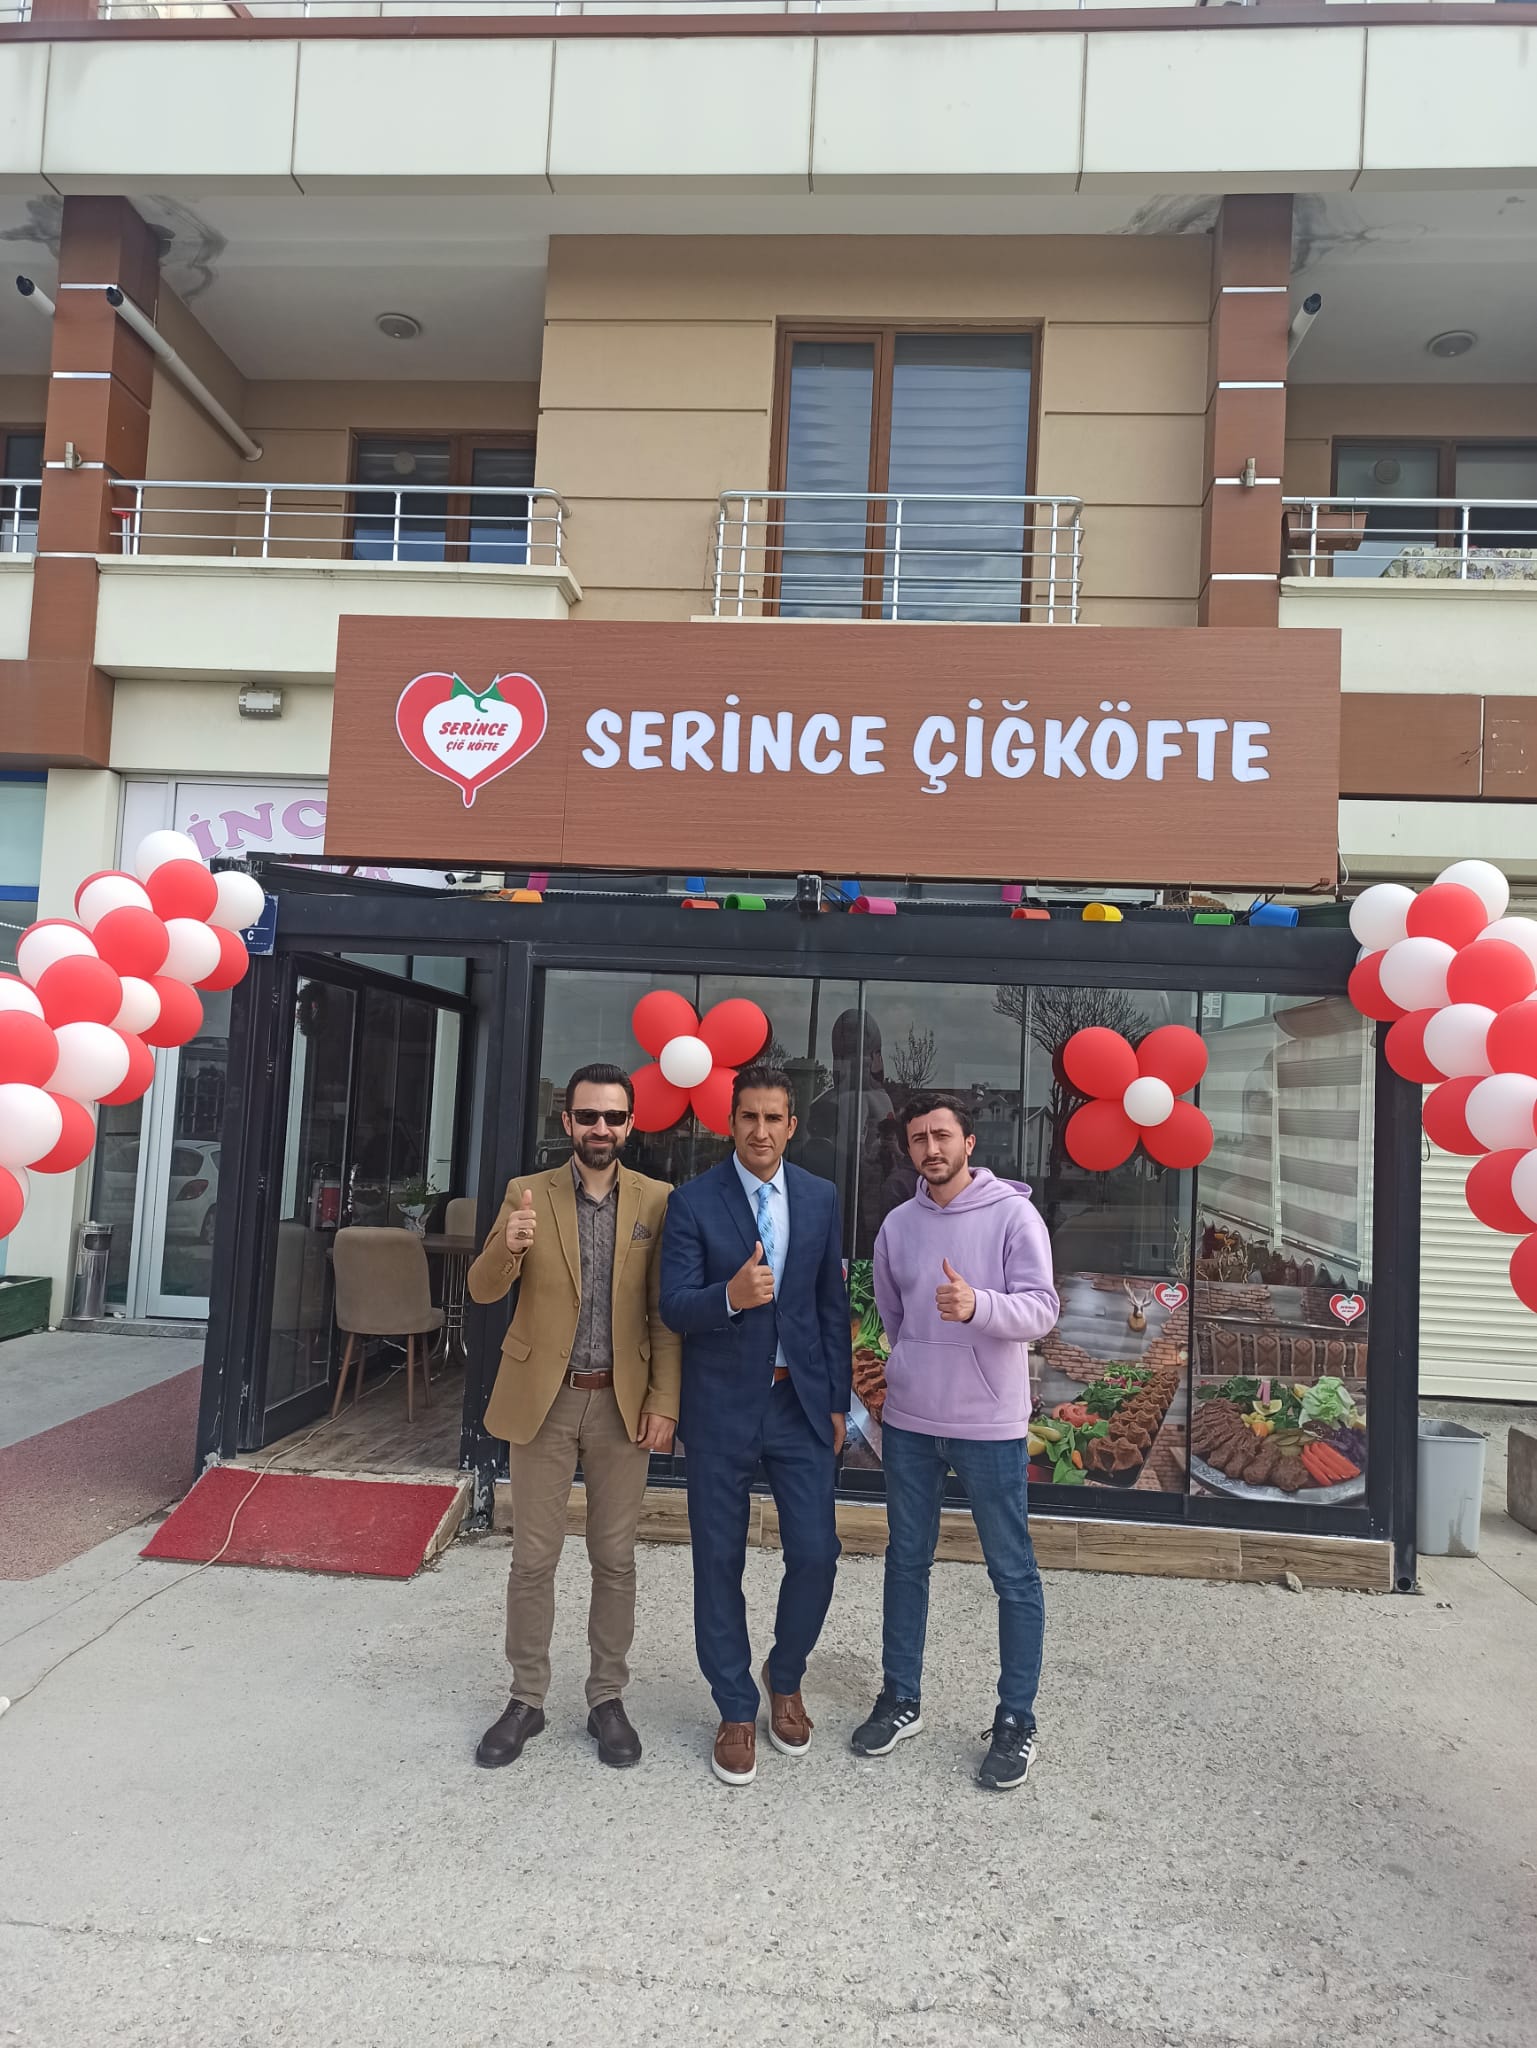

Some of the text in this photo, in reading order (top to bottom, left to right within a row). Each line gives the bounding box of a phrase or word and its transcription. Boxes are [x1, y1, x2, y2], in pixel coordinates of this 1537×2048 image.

[438, 718, 509, 737] SERİNCE
[446, 739, 500, 753] ÇİĞ KÖFTE
[582, 694, 1271, 794] SERİNCE ÇİĞKÖFTE
